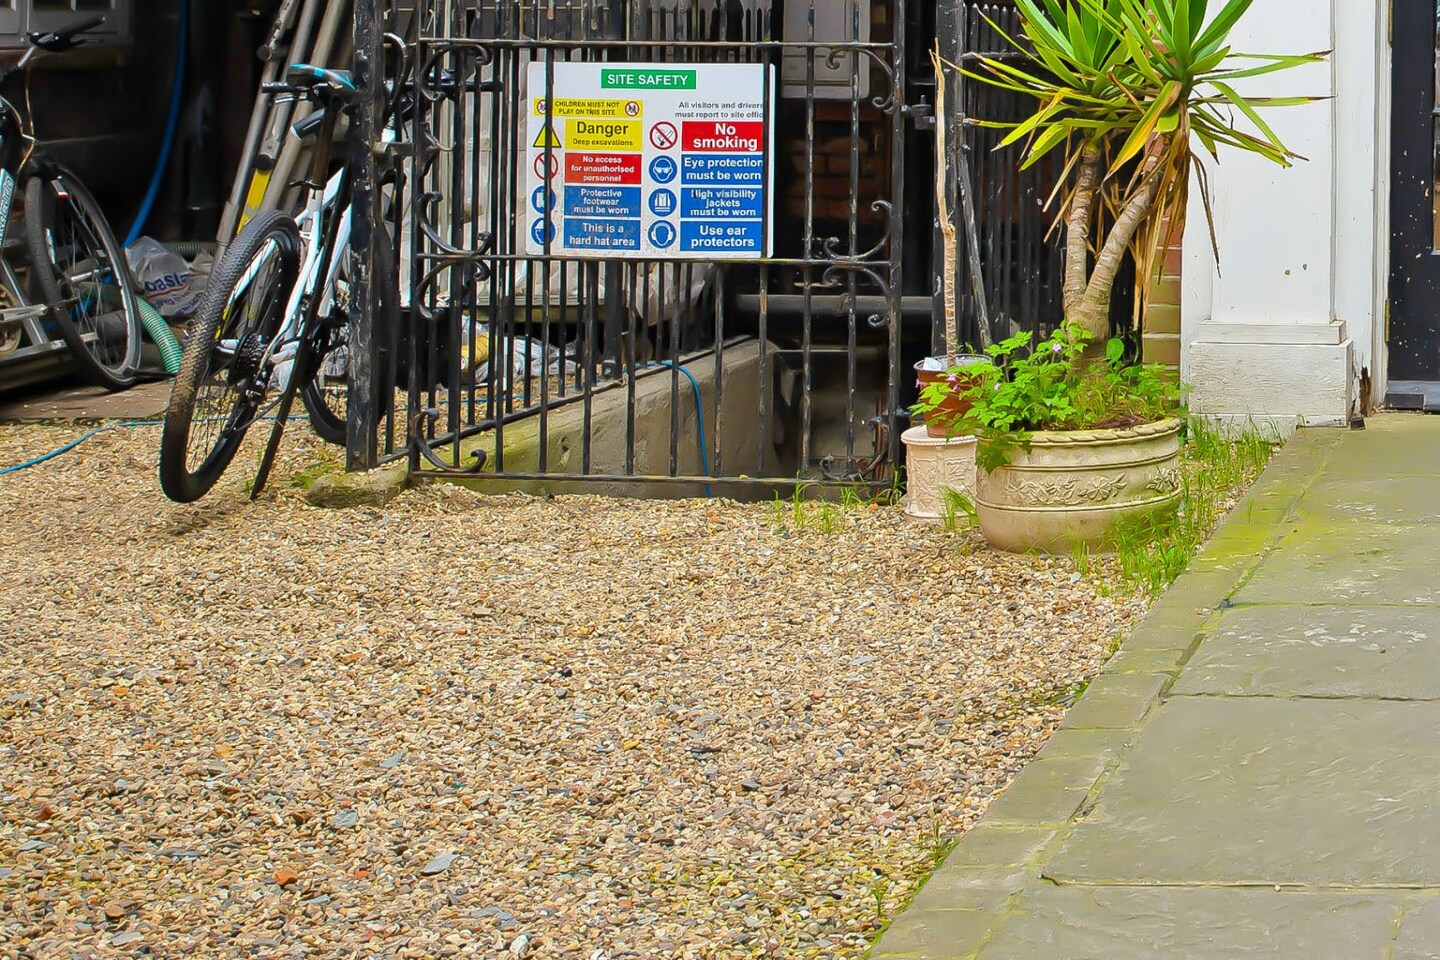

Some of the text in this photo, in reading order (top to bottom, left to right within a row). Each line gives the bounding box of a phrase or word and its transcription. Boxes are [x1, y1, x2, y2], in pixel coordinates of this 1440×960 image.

[607, 74, 689, 86] SITE SAFETY
[678, 101, 689, 109] All
[577, 121, 629, 138] Danger
[715, 123, 736, 135] No
[573, 138, 591, 146] Deep
[693, 136, 758, 151] smoking
[583, 155, 593, 163] No
[684, 158, 763, 169] Eye protection
[571, 164, 635, 173] for unauthorised
[583, 175, 622, 183] personnel
[686, 172, 714, 180] must
[717, 171, 730, 180] be
[580, 188, 622, 197] Protective
[715, 189, 757, 200] visibility
[583, 197, 620, 206] footwear
[705, 199, 741, 208] jackets
[573, 206, 594, 214] must
[595, 206, 606, 214] be
[717, 208, 729, 216] be
[582, 223, 604, 233] This
[606, 223, 615, 233] is
[699, 224, 748, 236] Use ear
[569, 235, 635, 247] hard hat area
[691, 237, 755, 249] protectors
